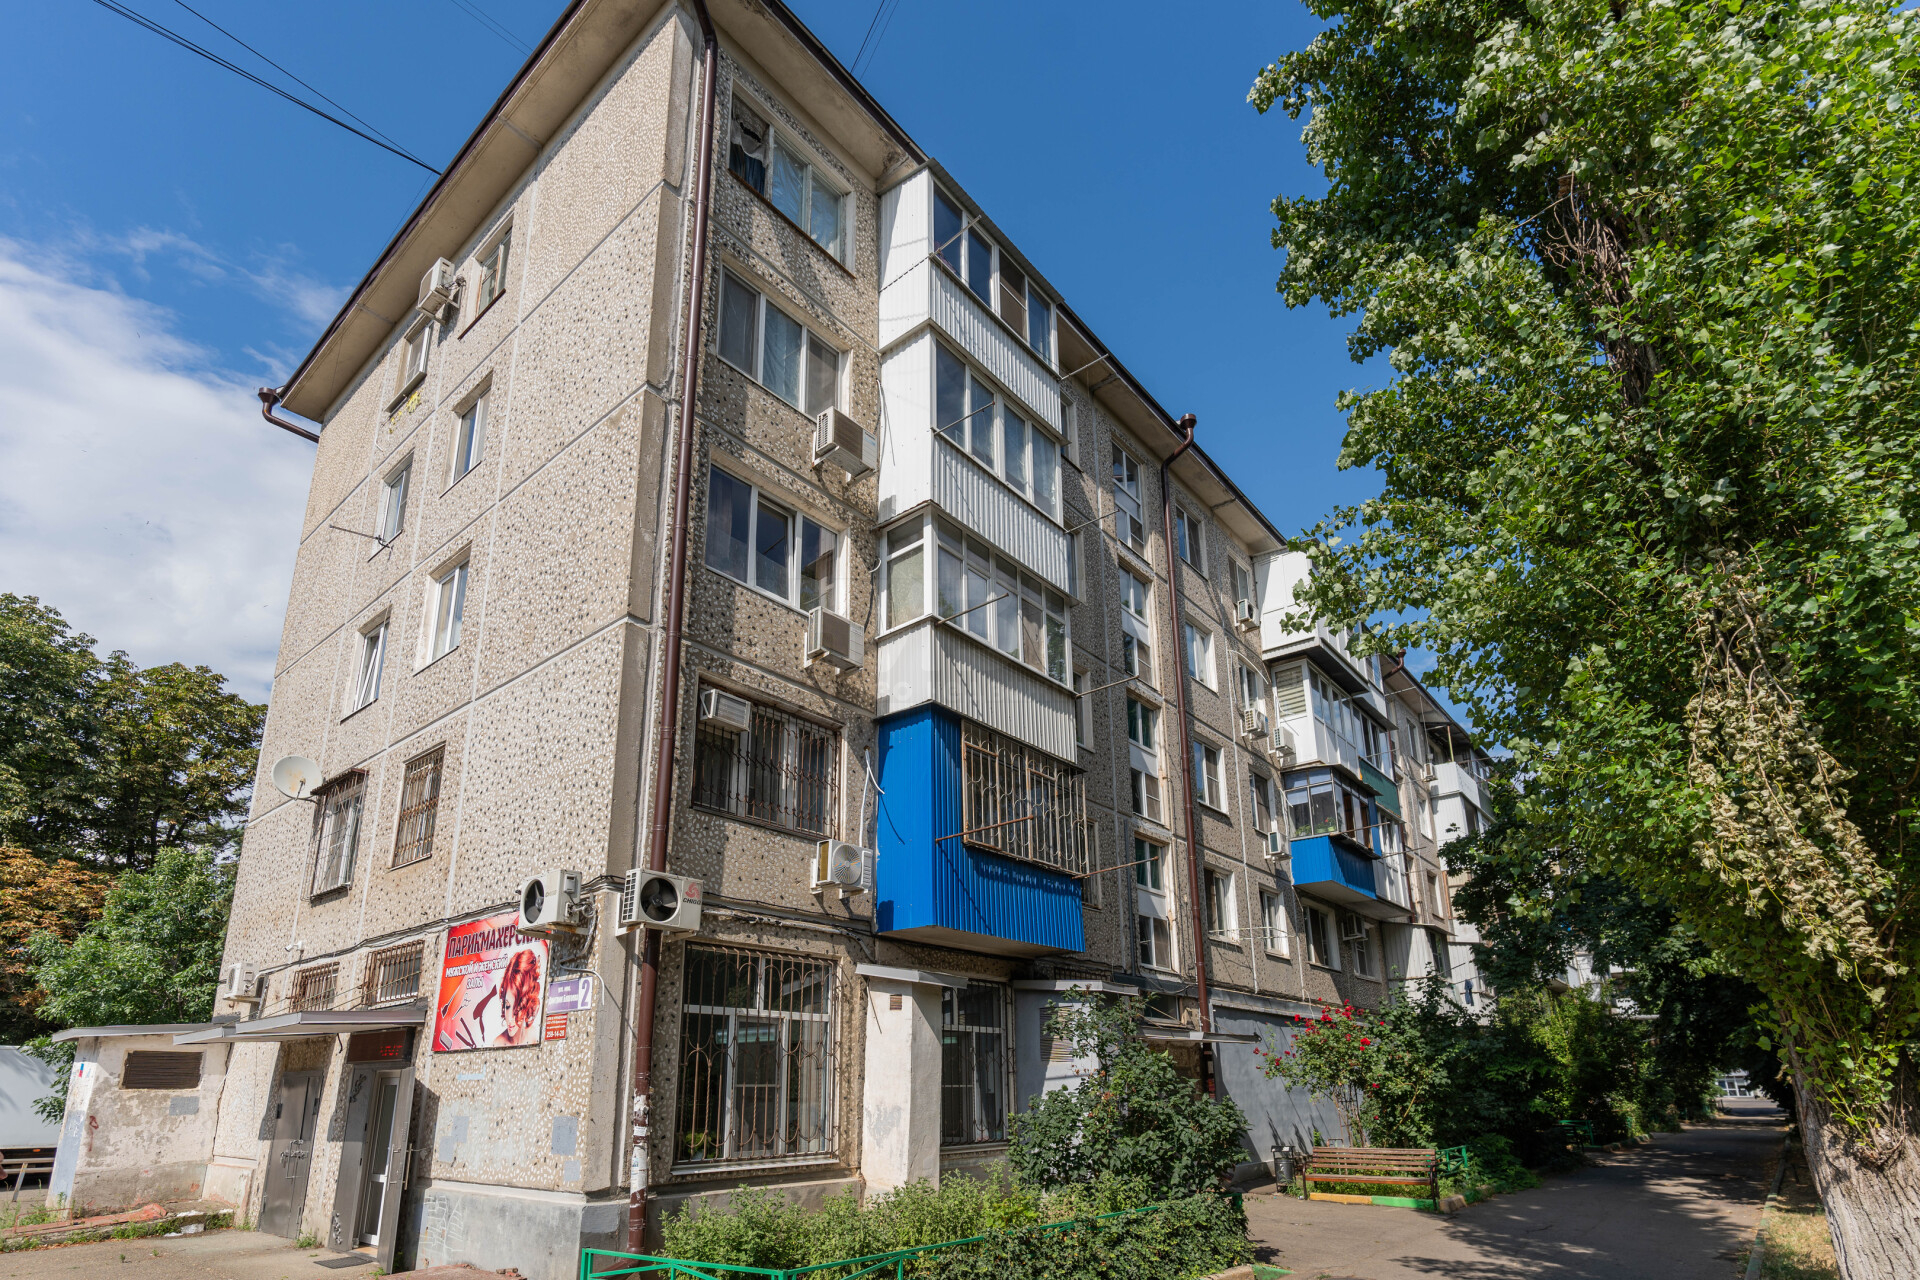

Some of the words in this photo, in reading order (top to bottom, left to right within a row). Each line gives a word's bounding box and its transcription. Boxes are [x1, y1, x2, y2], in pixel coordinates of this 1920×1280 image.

[682, 897, 701, 906] CHIGO
[448, 923, 540, 959] ПАРИКМАХЕРС
[445, 961, 473, 978] МУЖСКОЙ
[480, 953, 508, 973] ЖЕНСКИЙ
[466, 975, 485, 989] ЗАЛЫ
[580, 979, 591, 1007] 2
